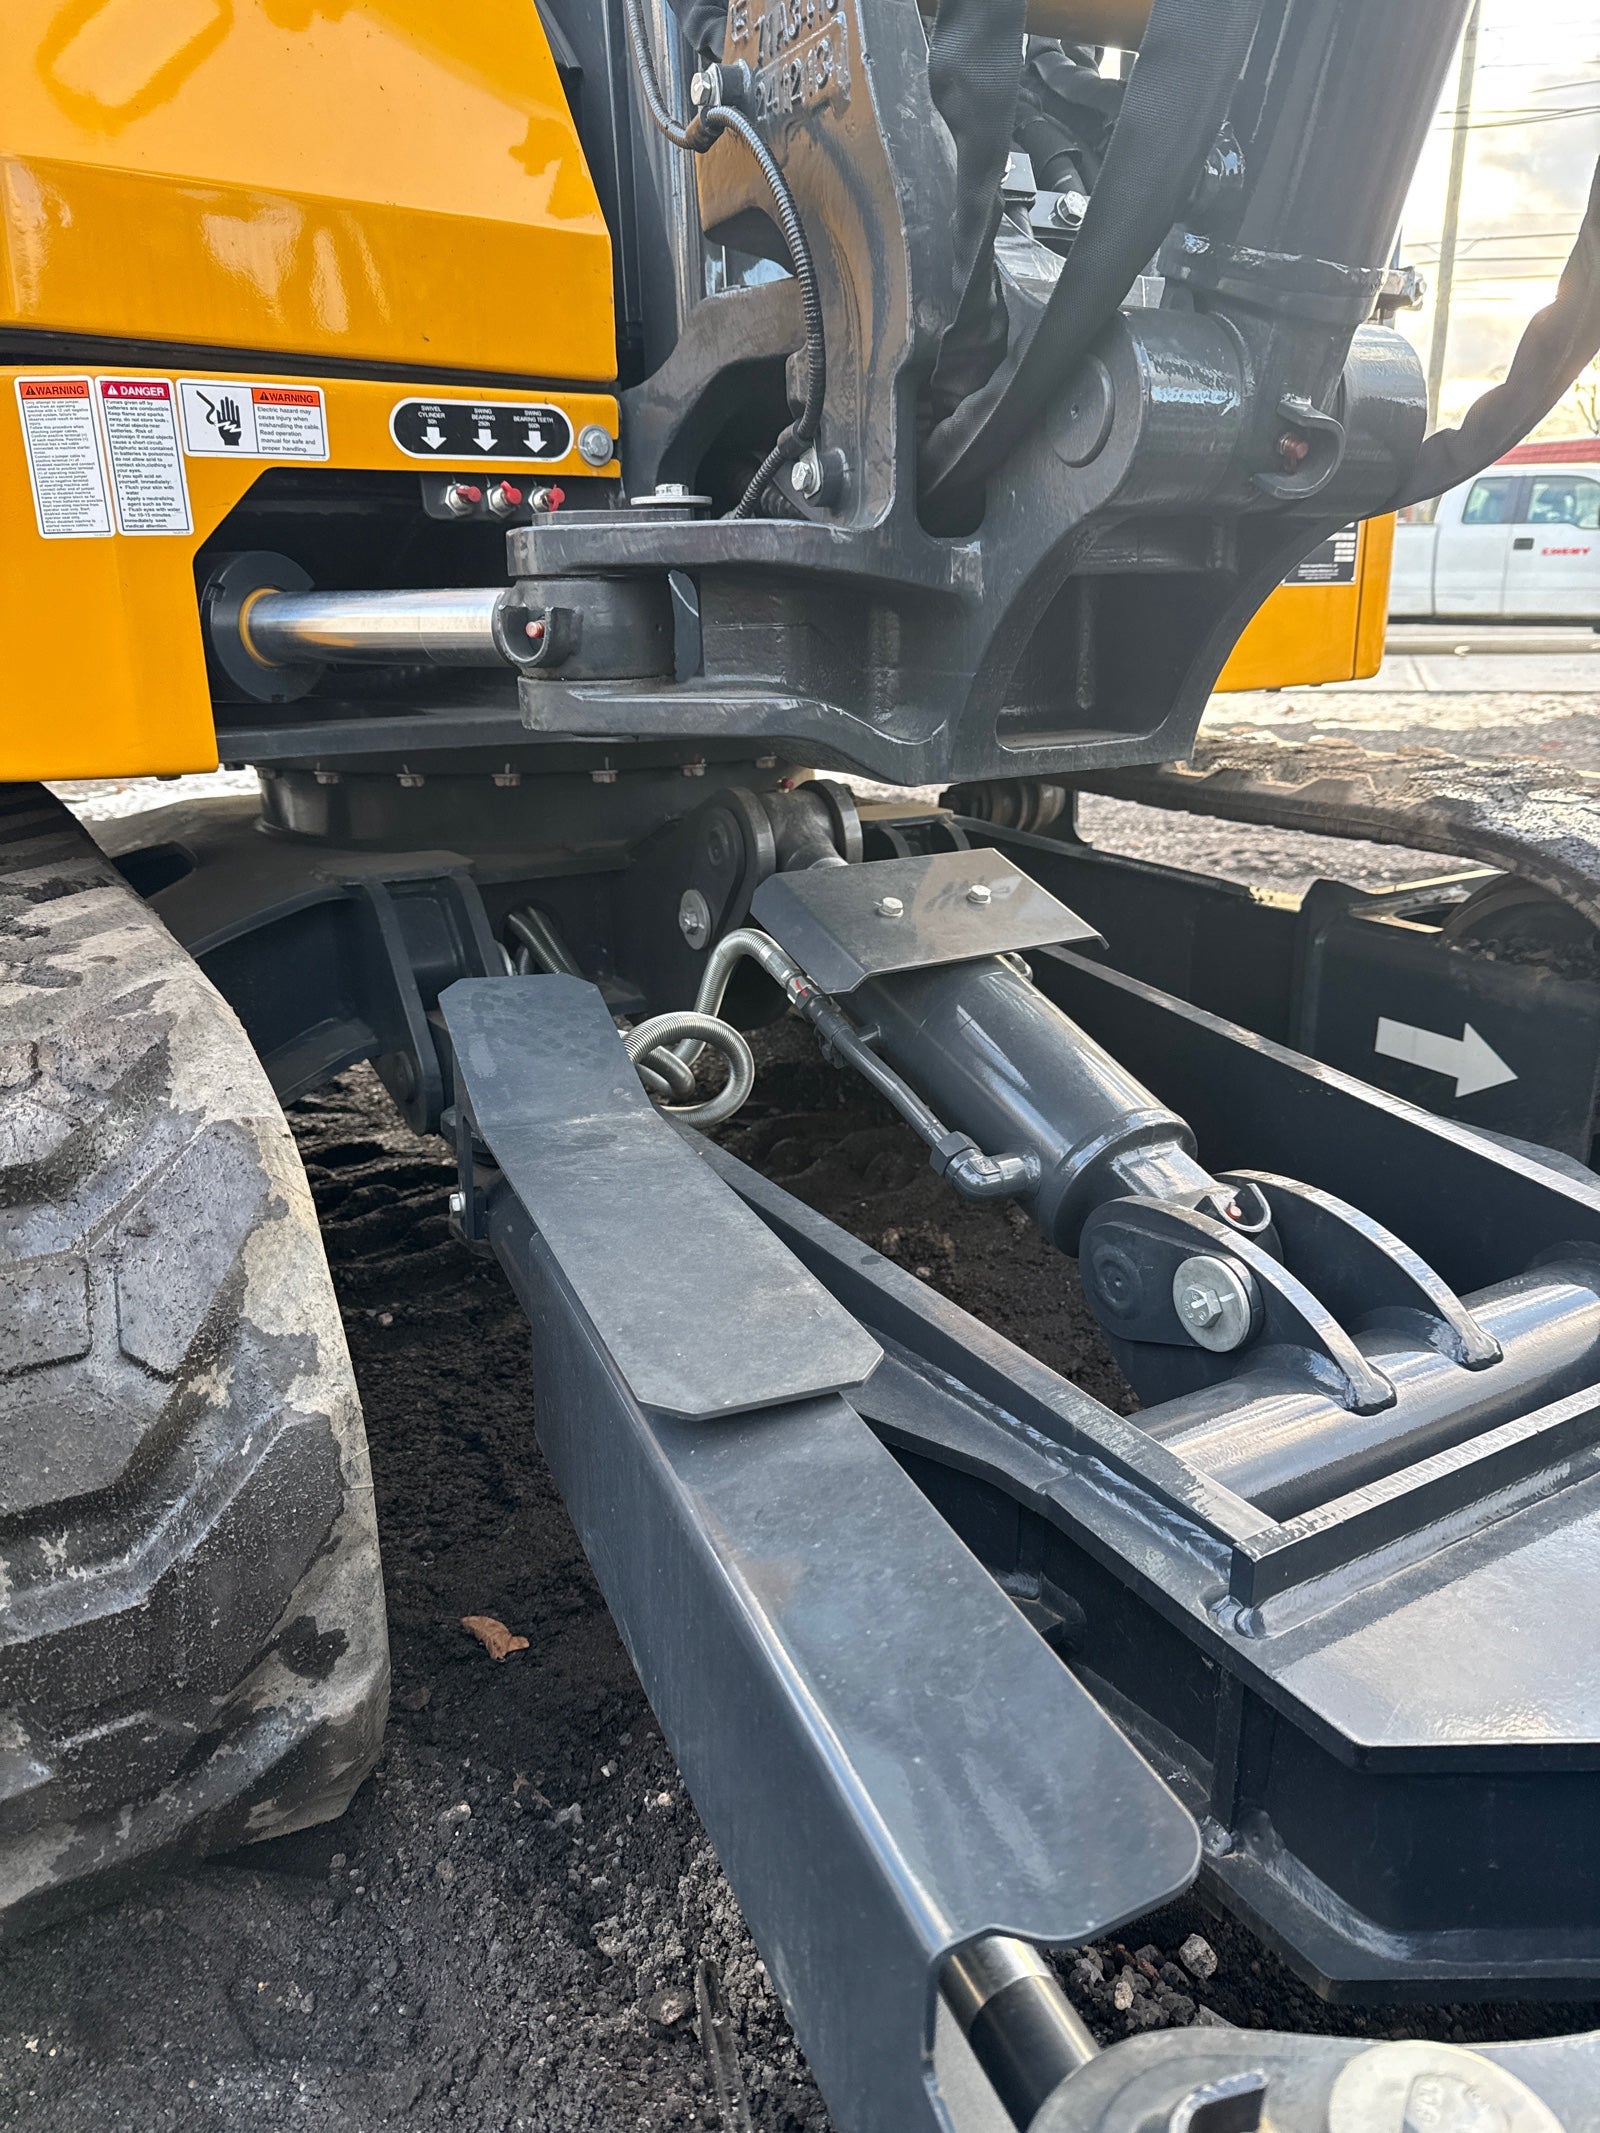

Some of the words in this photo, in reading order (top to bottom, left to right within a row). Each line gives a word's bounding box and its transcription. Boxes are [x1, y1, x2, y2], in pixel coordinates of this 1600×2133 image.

[36, 386, 84, 395] WARNING
[120, 386, 164, 396] DANGER
[269, 393, 313, 403] WARNING
